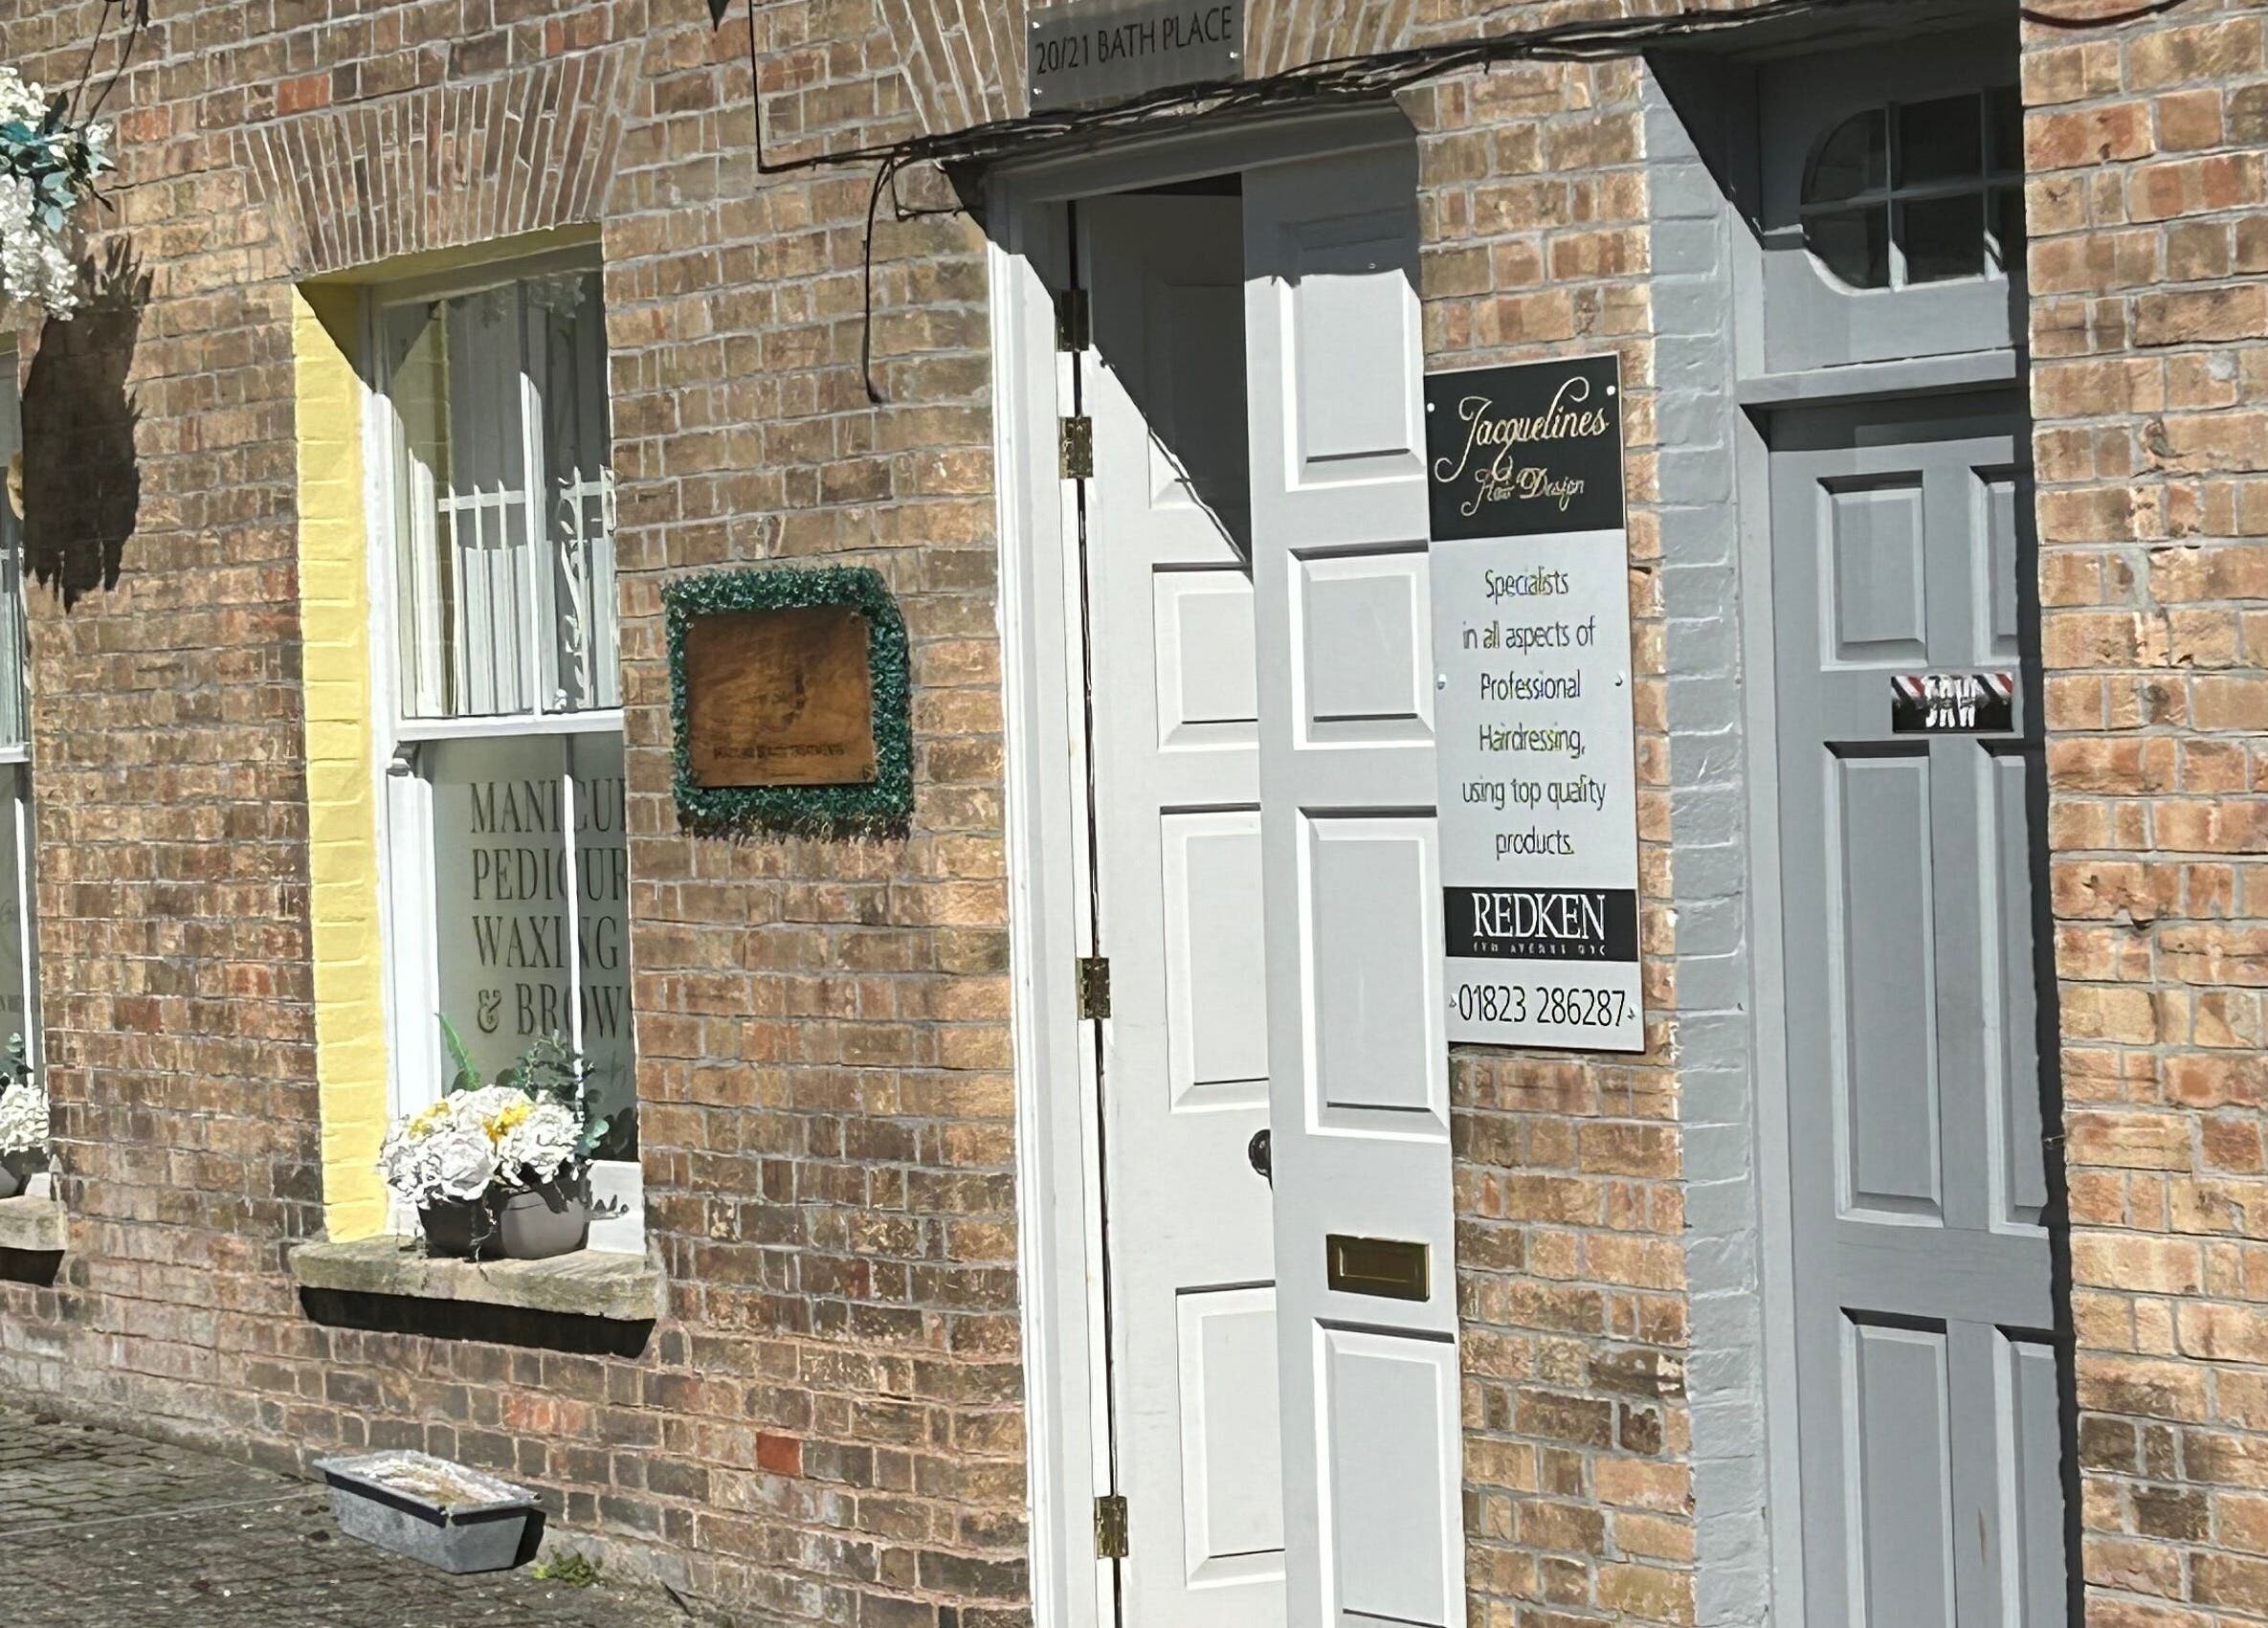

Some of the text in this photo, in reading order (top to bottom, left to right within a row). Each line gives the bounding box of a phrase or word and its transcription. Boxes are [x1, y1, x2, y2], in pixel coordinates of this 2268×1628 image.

[1035, 6, 1233, 75] 20/21 BATH PLACE
[1516, 467, 1585, 511] Design
[1485, 567, 1569, 604] Specialists
[1462, 615, 1596, 655] in all aspects of
[1480, 669, 1581, 701] Professional
[1479, 723, 1586, 759] Hairdressing,
[1462, 775, 1606, 811] using top quality
[1472, 893, 1606, 940] REDKEN
[478, 989, 501, 1035] &
[1458, 984, 1625, 1027] 01823 286287
